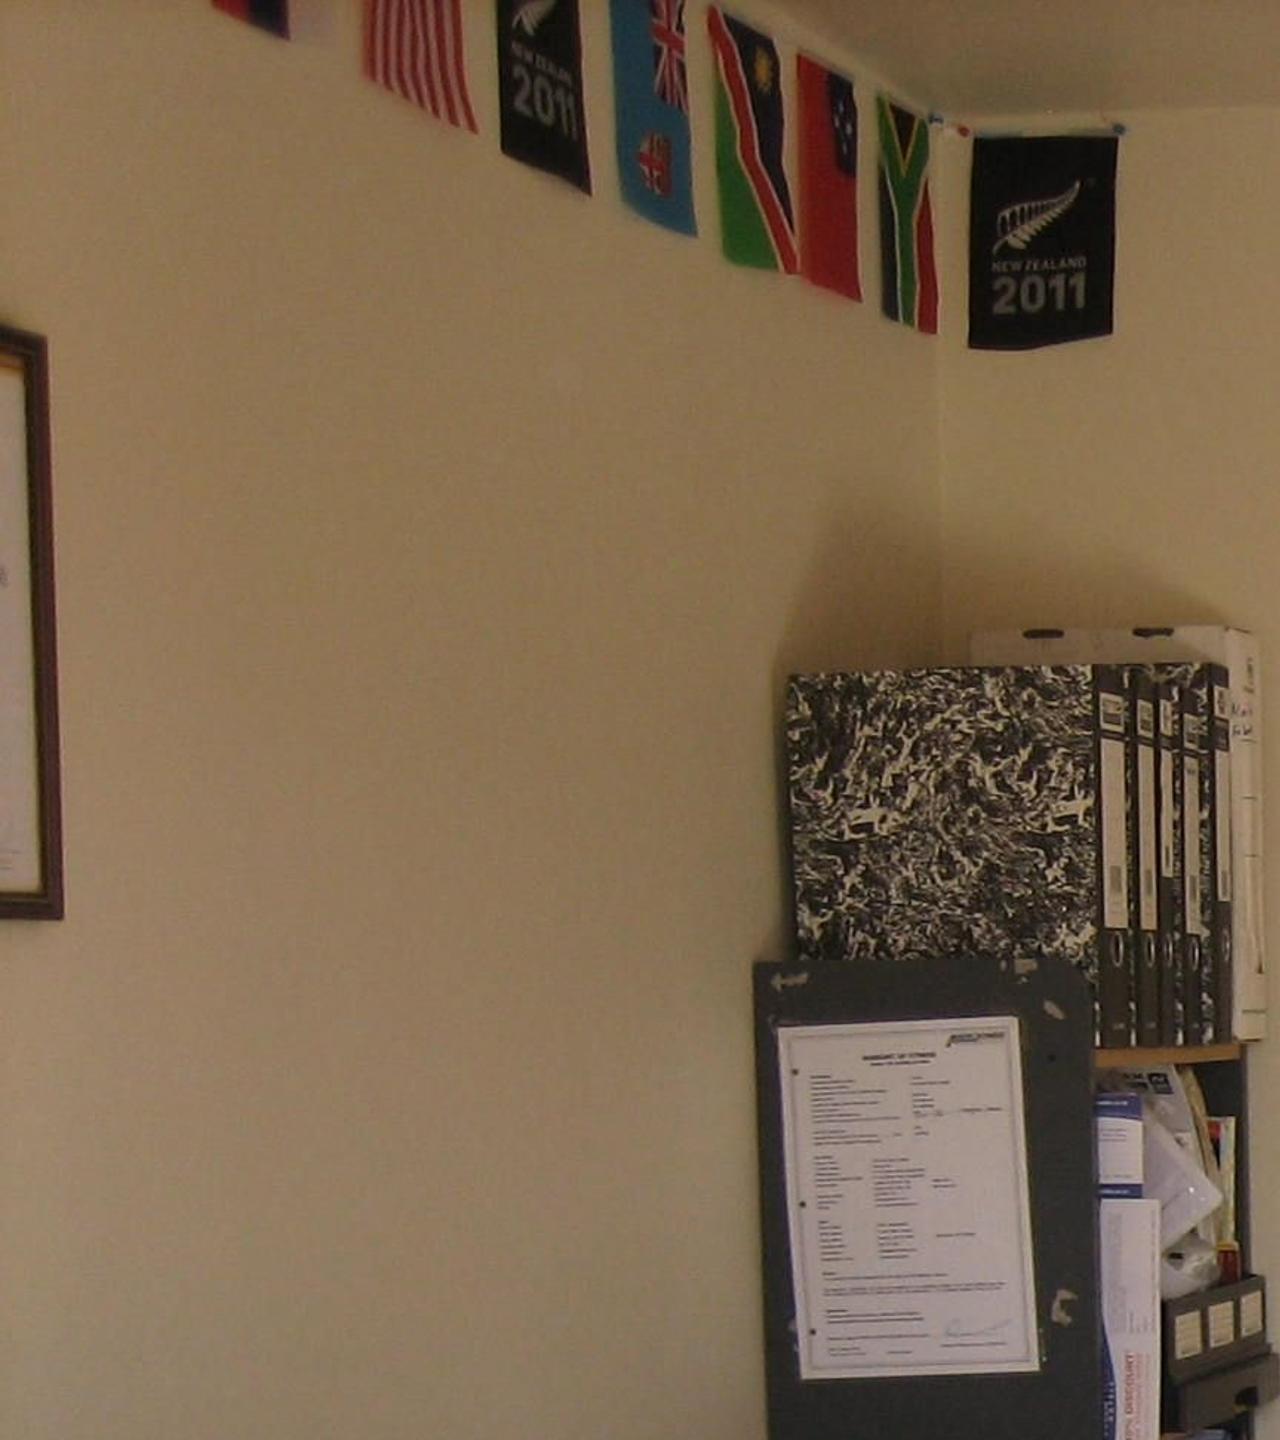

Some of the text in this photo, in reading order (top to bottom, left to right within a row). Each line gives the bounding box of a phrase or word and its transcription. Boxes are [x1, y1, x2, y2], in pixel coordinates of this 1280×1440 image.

[513, 64, 577, 141] 2011
[991, 256, 1087, 272] NEW ZEALAND
[992, 272, 1086, 315] 2011
